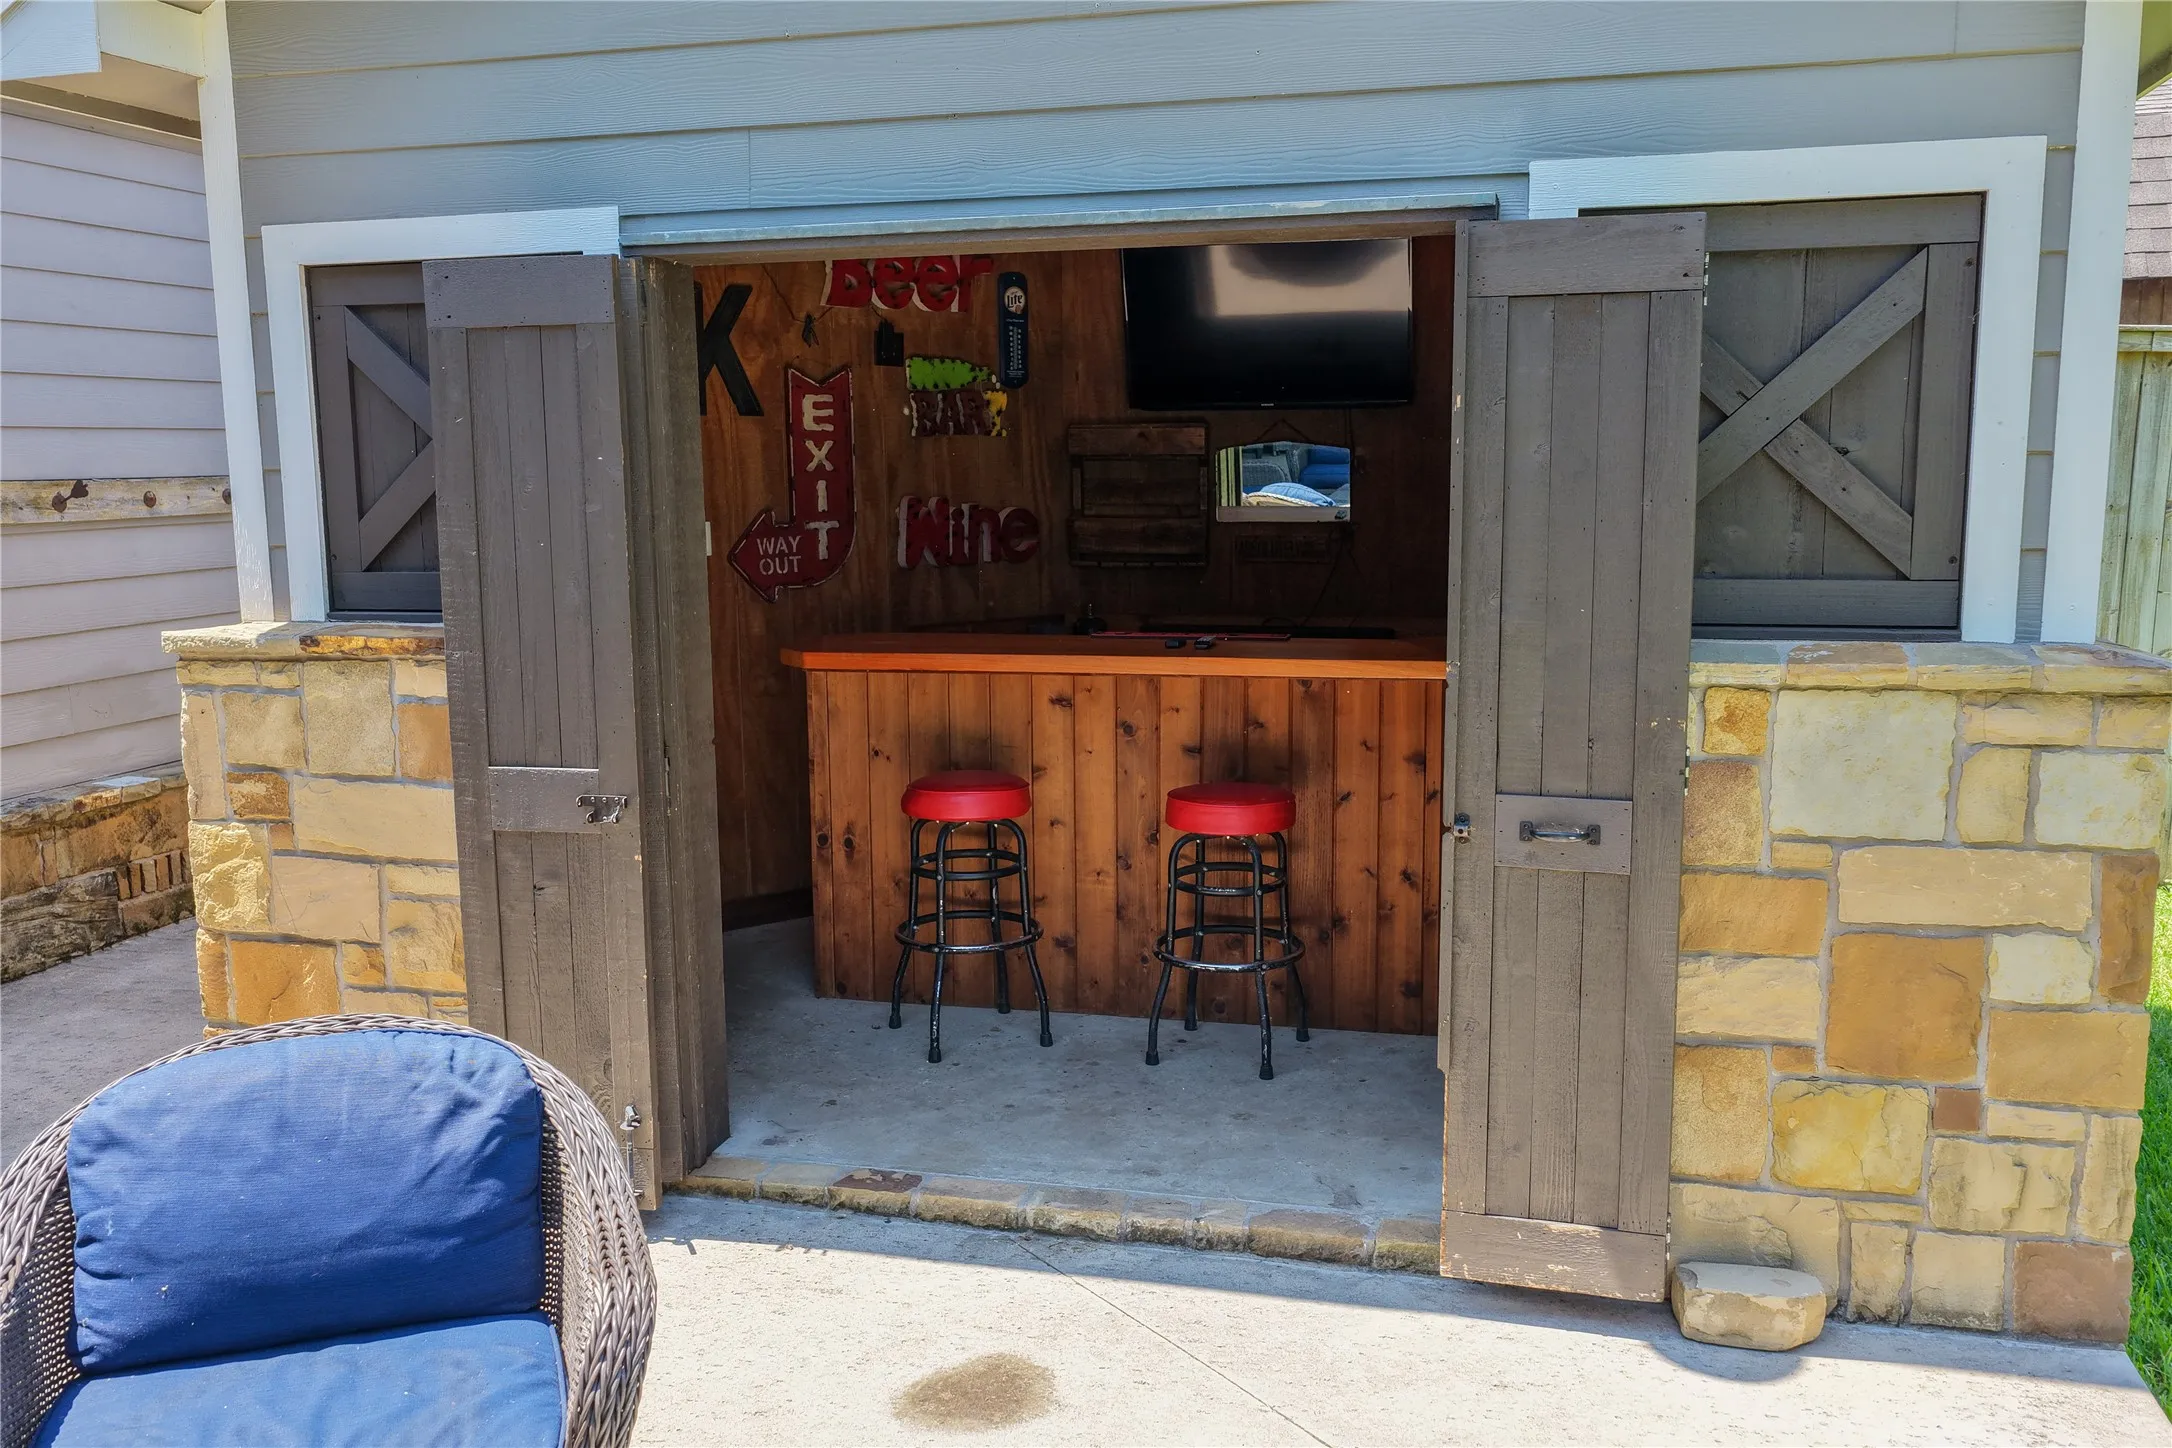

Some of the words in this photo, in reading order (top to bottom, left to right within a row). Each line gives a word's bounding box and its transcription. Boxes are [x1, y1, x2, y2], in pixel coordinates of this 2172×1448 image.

[1007, 294, 1023, 308] Lite
[910, 392, 988, 436] BAR
[802, 394, 839, 560] EXIT
[757, 535, 801, 555] WAY
[896, 496, 1040, 569] Wine
[758, 556, 801, 575] OUT
